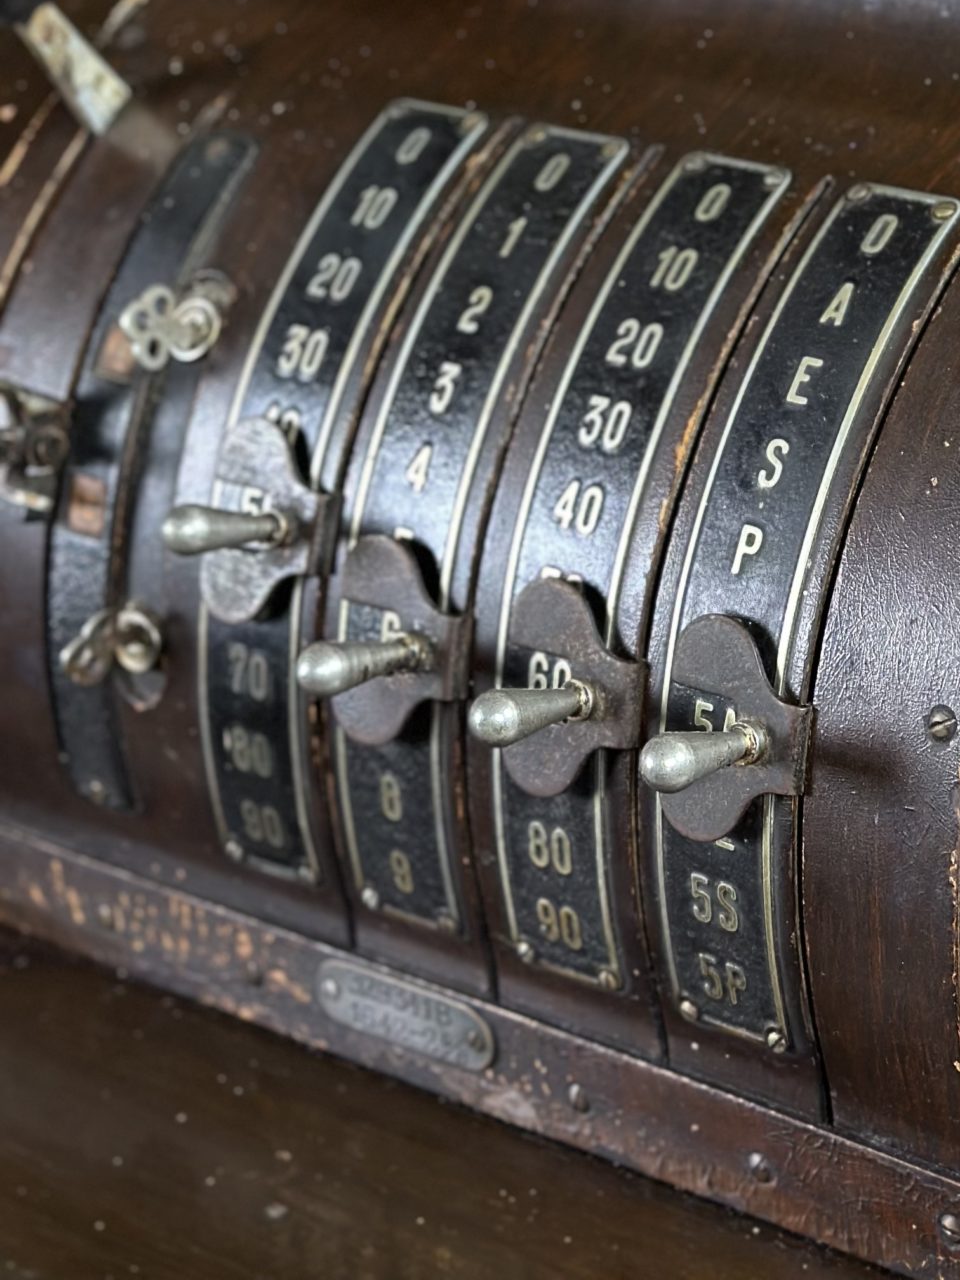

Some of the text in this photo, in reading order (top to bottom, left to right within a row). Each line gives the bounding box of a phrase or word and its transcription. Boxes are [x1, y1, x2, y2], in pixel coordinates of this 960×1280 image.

[395, 127, 431, 165] 0
[533, 153, 570, 191] 0
[351, 185, 398, 229] 10
[694, 183, 731, 221] 0
[499, 215, 527, 258] 1
[306, 253, 362, 301] 20
[650, 246, 698, 291] 10
[456, 286, 493, 334] 2
[819, 281, 855, 326] A
[277, 325, 329, 381] 30
[605, 317, 663, 369] 20
[429, 361, 462, 414] 3
[786, 356, 824, 405] E
[578, 395, 631, 451] 30
[406, 441, 433, 491] 4
[758, 438, 789, 489] S
[553, 480, 603, 535] 40
[730, 524, 763, 575] P
[228, 642, 268, 701] 70
[389, 850, 414, 894] 9
[527, 821, 572, 876] 80
[535, 897, 581, 951] 90
[690, 872, 739, 932] 5S
[698, 952, 747, 1006] 5P
